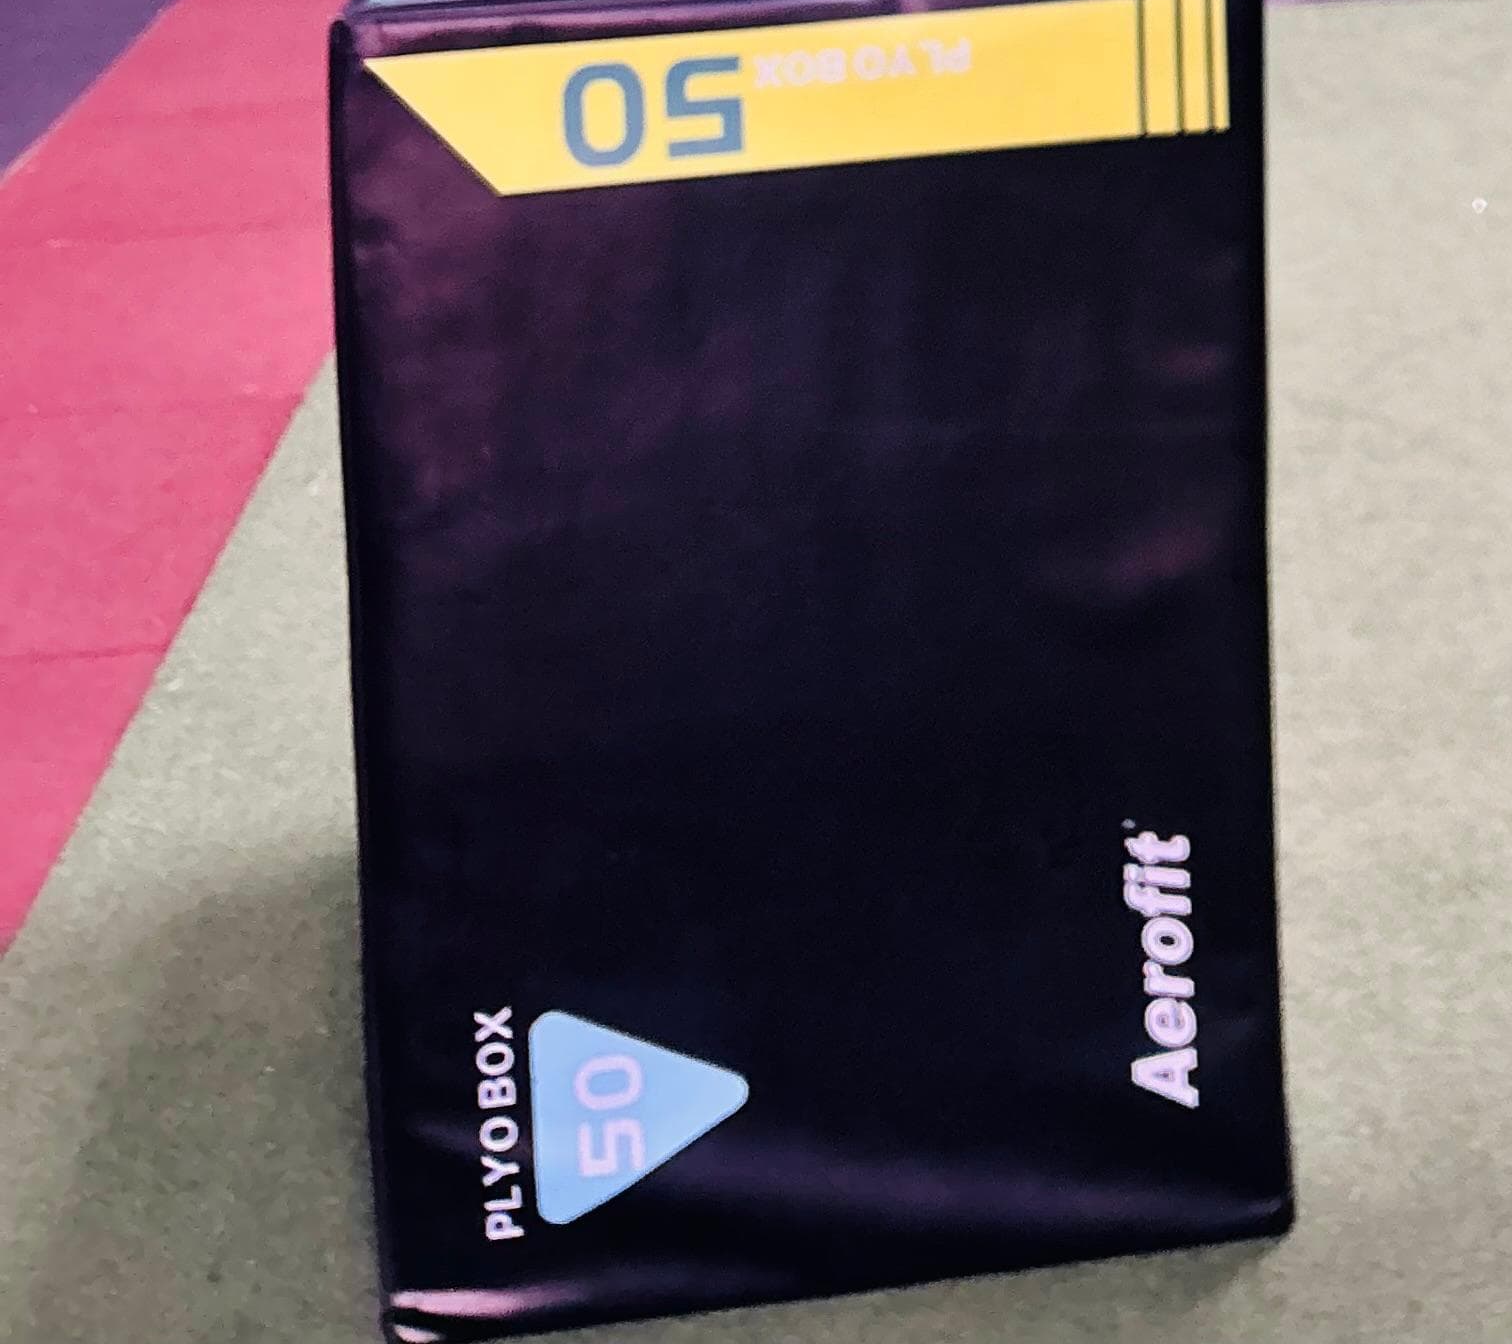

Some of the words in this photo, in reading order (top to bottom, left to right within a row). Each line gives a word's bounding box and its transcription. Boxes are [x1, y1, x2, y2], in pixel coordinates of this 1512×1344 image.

[563, 55, 745, 169] 50
[753, 48, 847, 89] BOX
[853, 37, 971, 81] PLYO
[1123, 830, 1199, 1109] Aerofit
[473, 1005, 517, 1109] BOX
[574, 1053, 645, 1178] 50
[479, 1116, 525, 1241] PLYO
